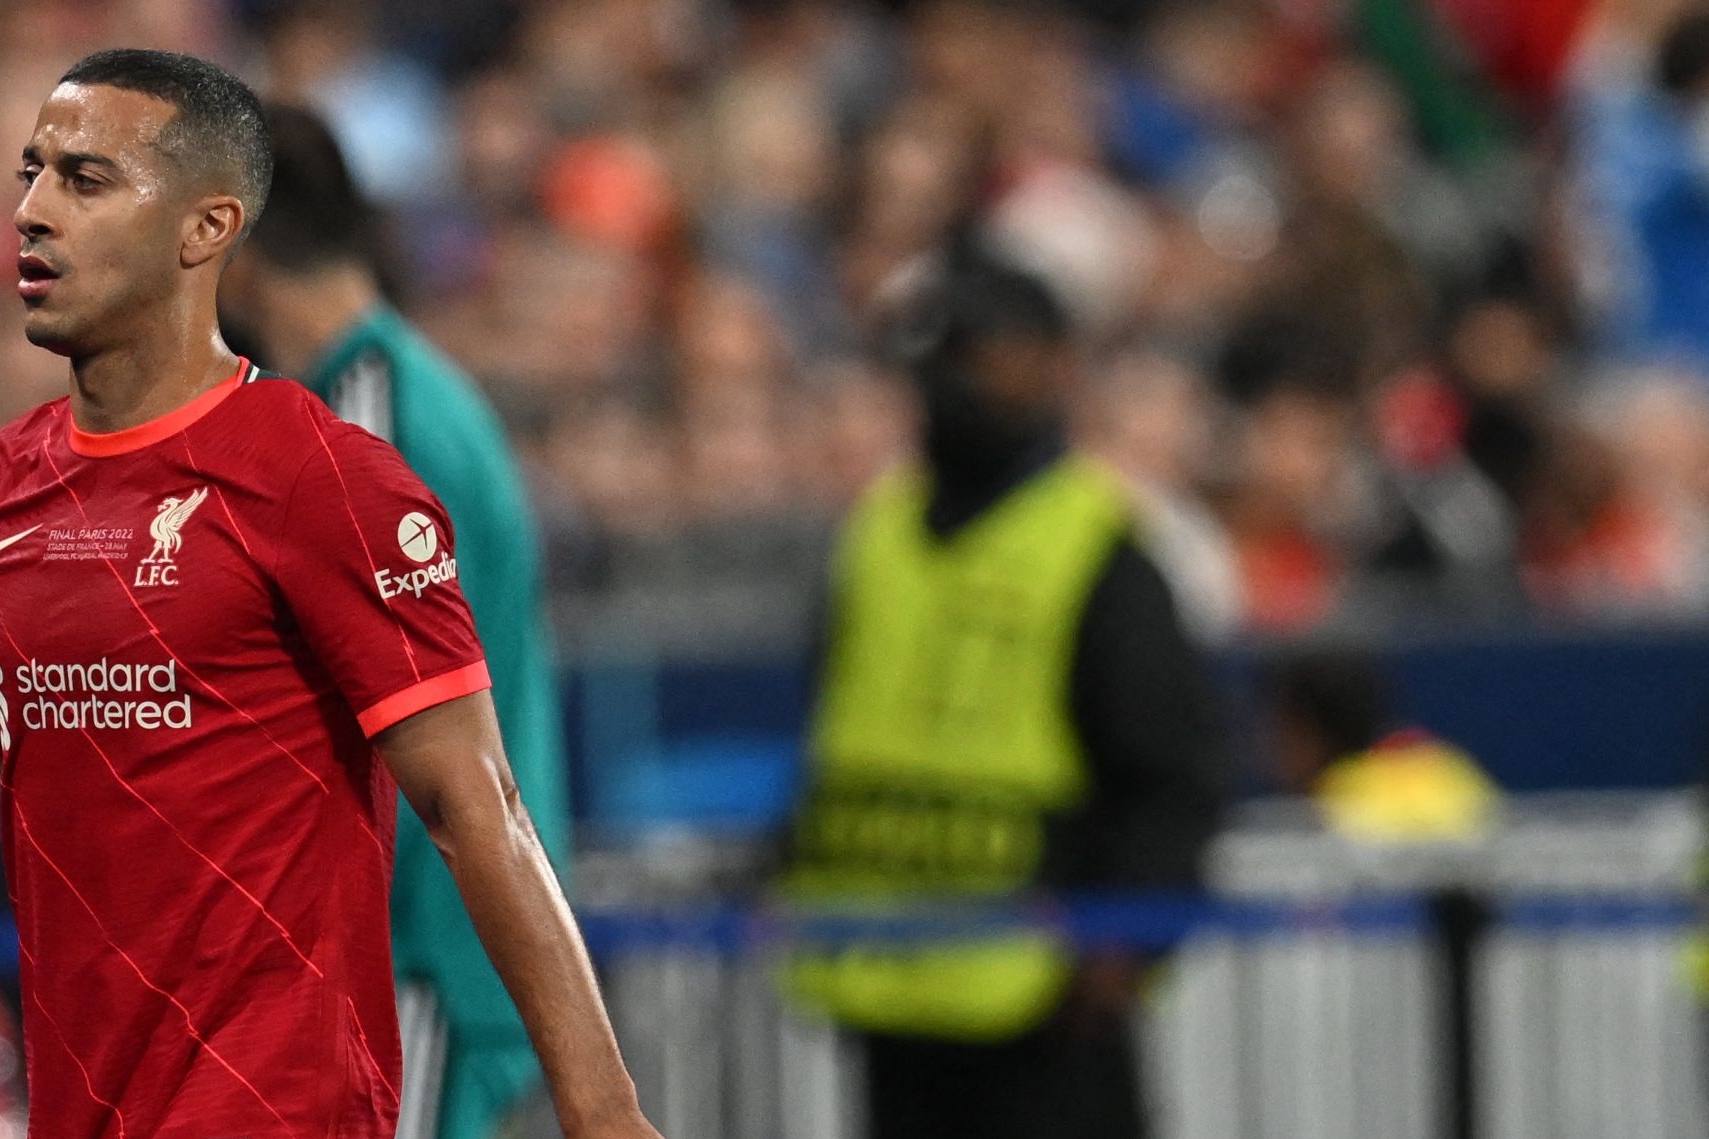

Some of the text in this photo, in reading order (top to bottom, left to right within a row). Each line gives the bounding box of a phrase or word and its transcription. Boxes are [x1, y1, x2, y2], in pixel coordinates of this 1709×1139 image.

[49, 528, 133, 540] FINAL PARIS 2022
[15, 656, 176, 693] standard
[22, 693, 192, 730] chartered
